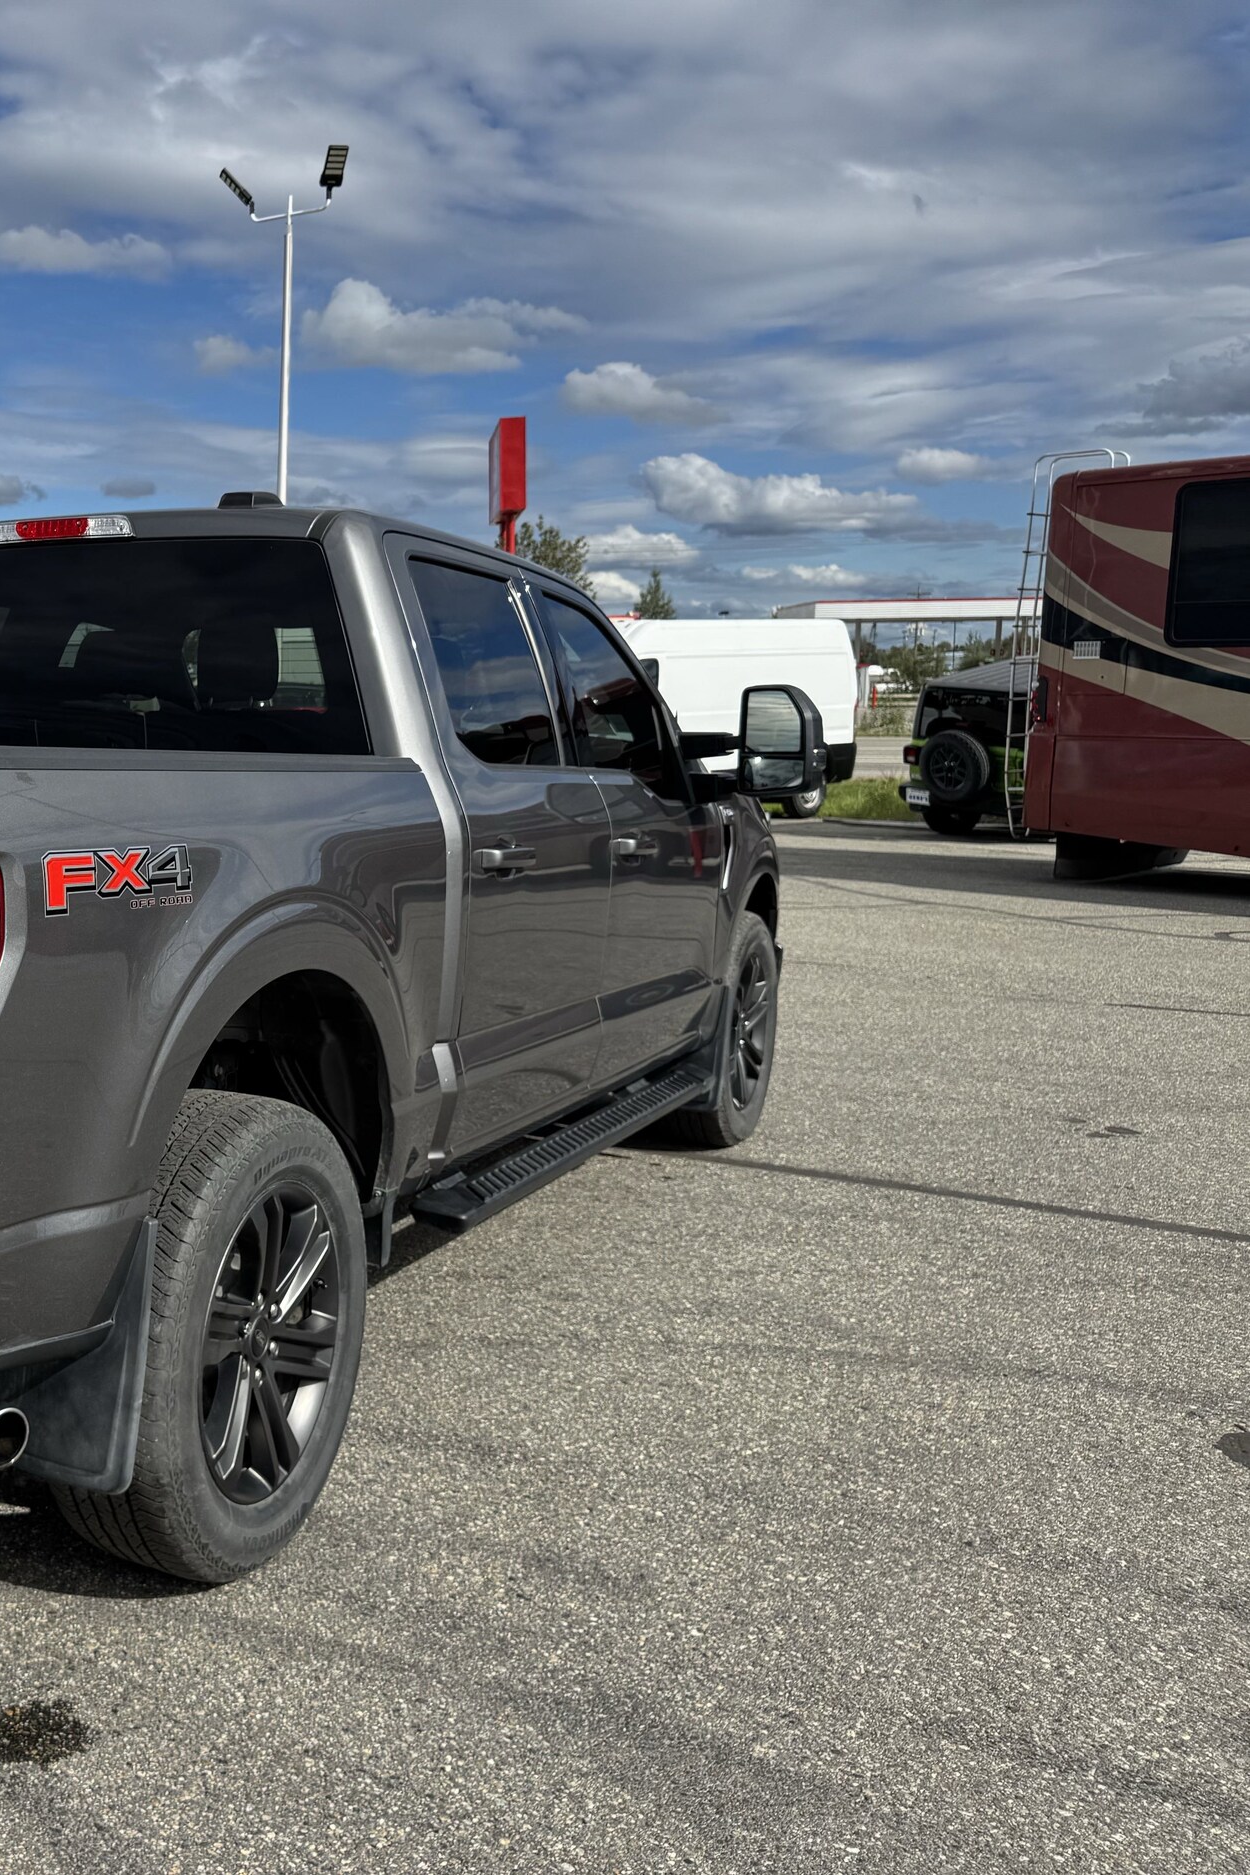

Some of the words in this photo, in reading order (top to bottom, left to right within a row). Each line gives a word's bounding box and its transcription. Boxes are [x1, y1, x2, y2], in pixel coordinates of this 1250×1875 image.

[41, 843, 193, 918] FX4
[129, 897, 155, 910] OFF
[159, 894, 193, 907] ROAD
